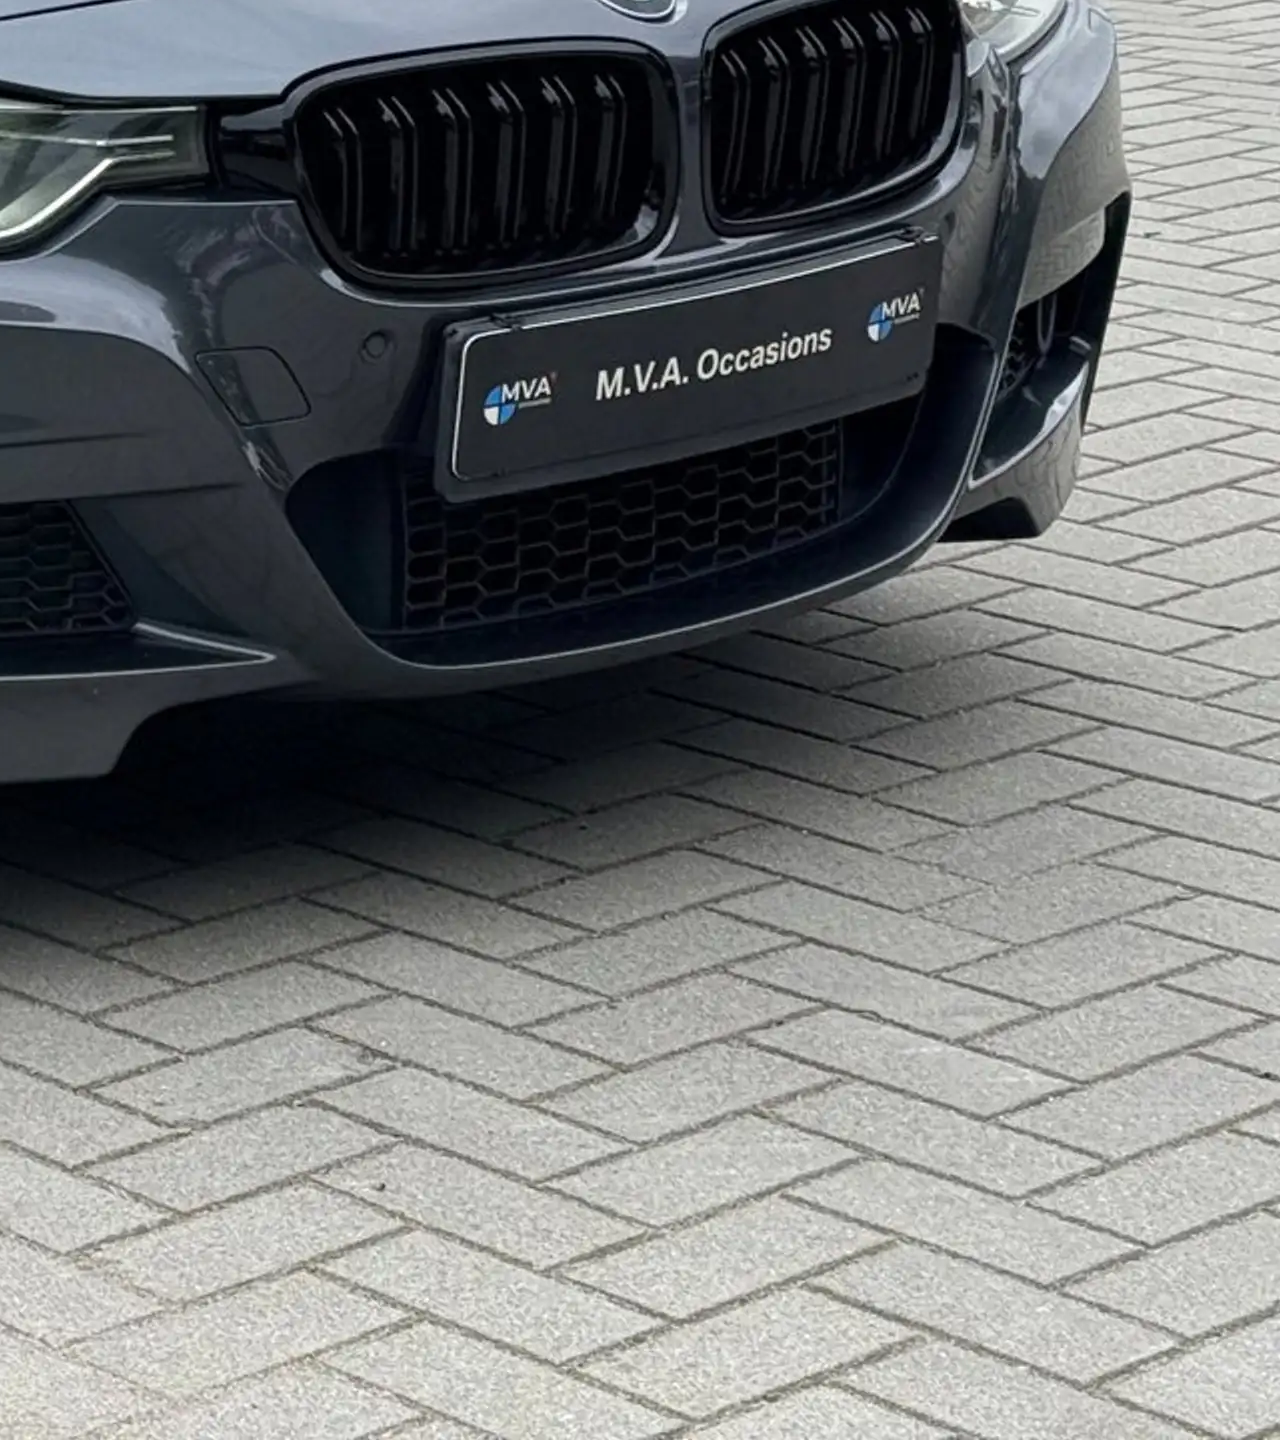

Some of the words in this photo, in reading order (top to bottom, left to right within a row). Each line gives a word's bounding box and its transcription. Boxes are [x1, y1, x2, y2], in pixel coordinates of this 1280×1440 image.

[881, 291, 921, 321] MVA
[594, 356, 691, 402] M.V.A.
[696, 326, 833, 381] Occasions
[501, 375, 552, 404] MVA
